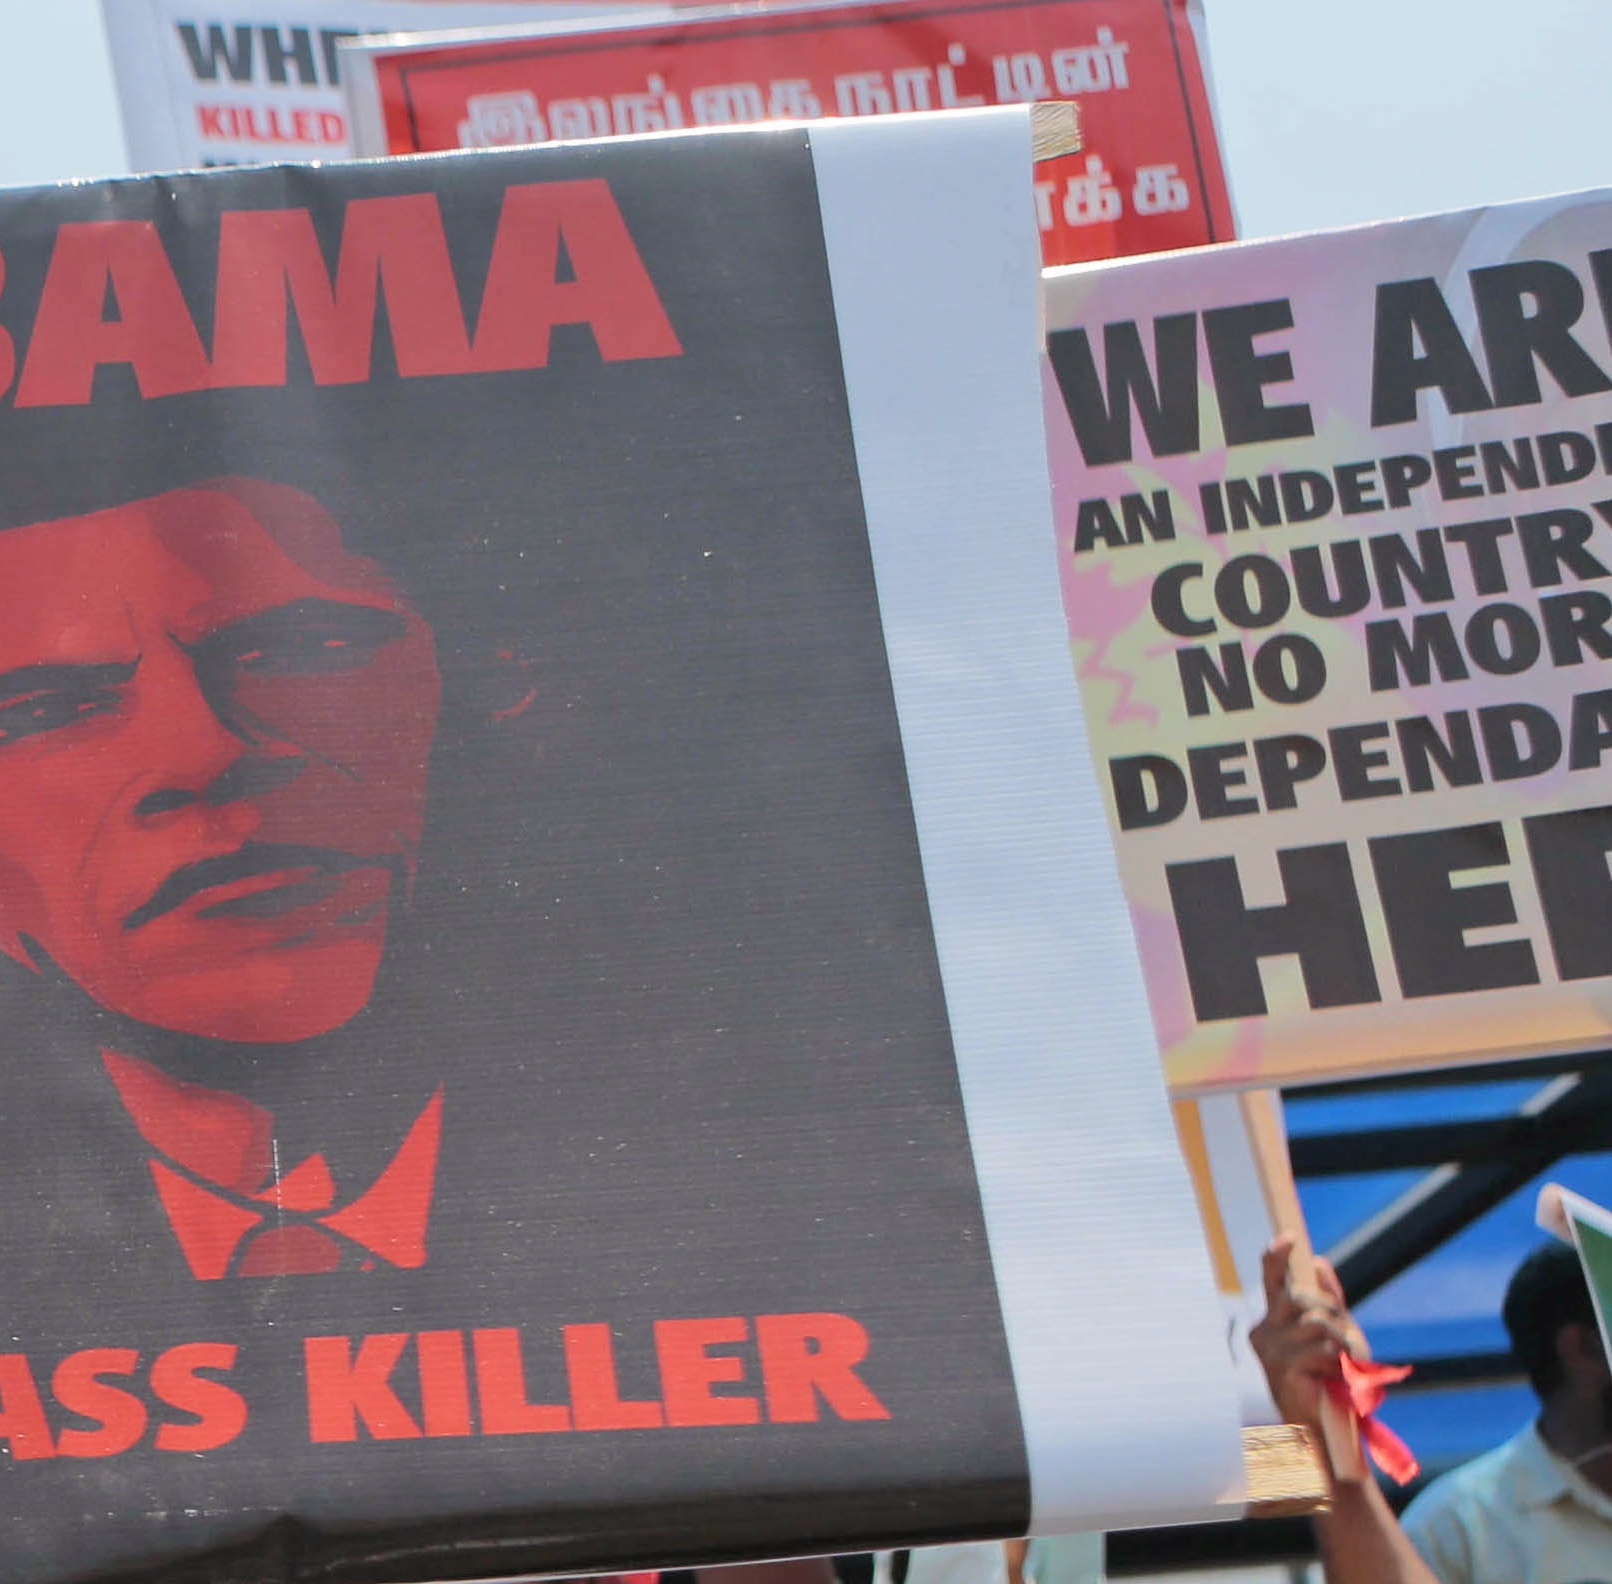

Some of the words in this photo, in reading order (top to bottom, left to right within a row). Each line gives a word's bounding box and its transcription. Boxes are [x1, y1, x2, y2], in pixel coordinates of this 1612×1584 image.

[195, 104, 349, 145] KILLED
[1046, 298, 1316, 468] WE
[1074, 488, 1177, 553] AN
[1176, 633, 1327, 717] NO
[305, 1311, 892, 1445] KILLER
